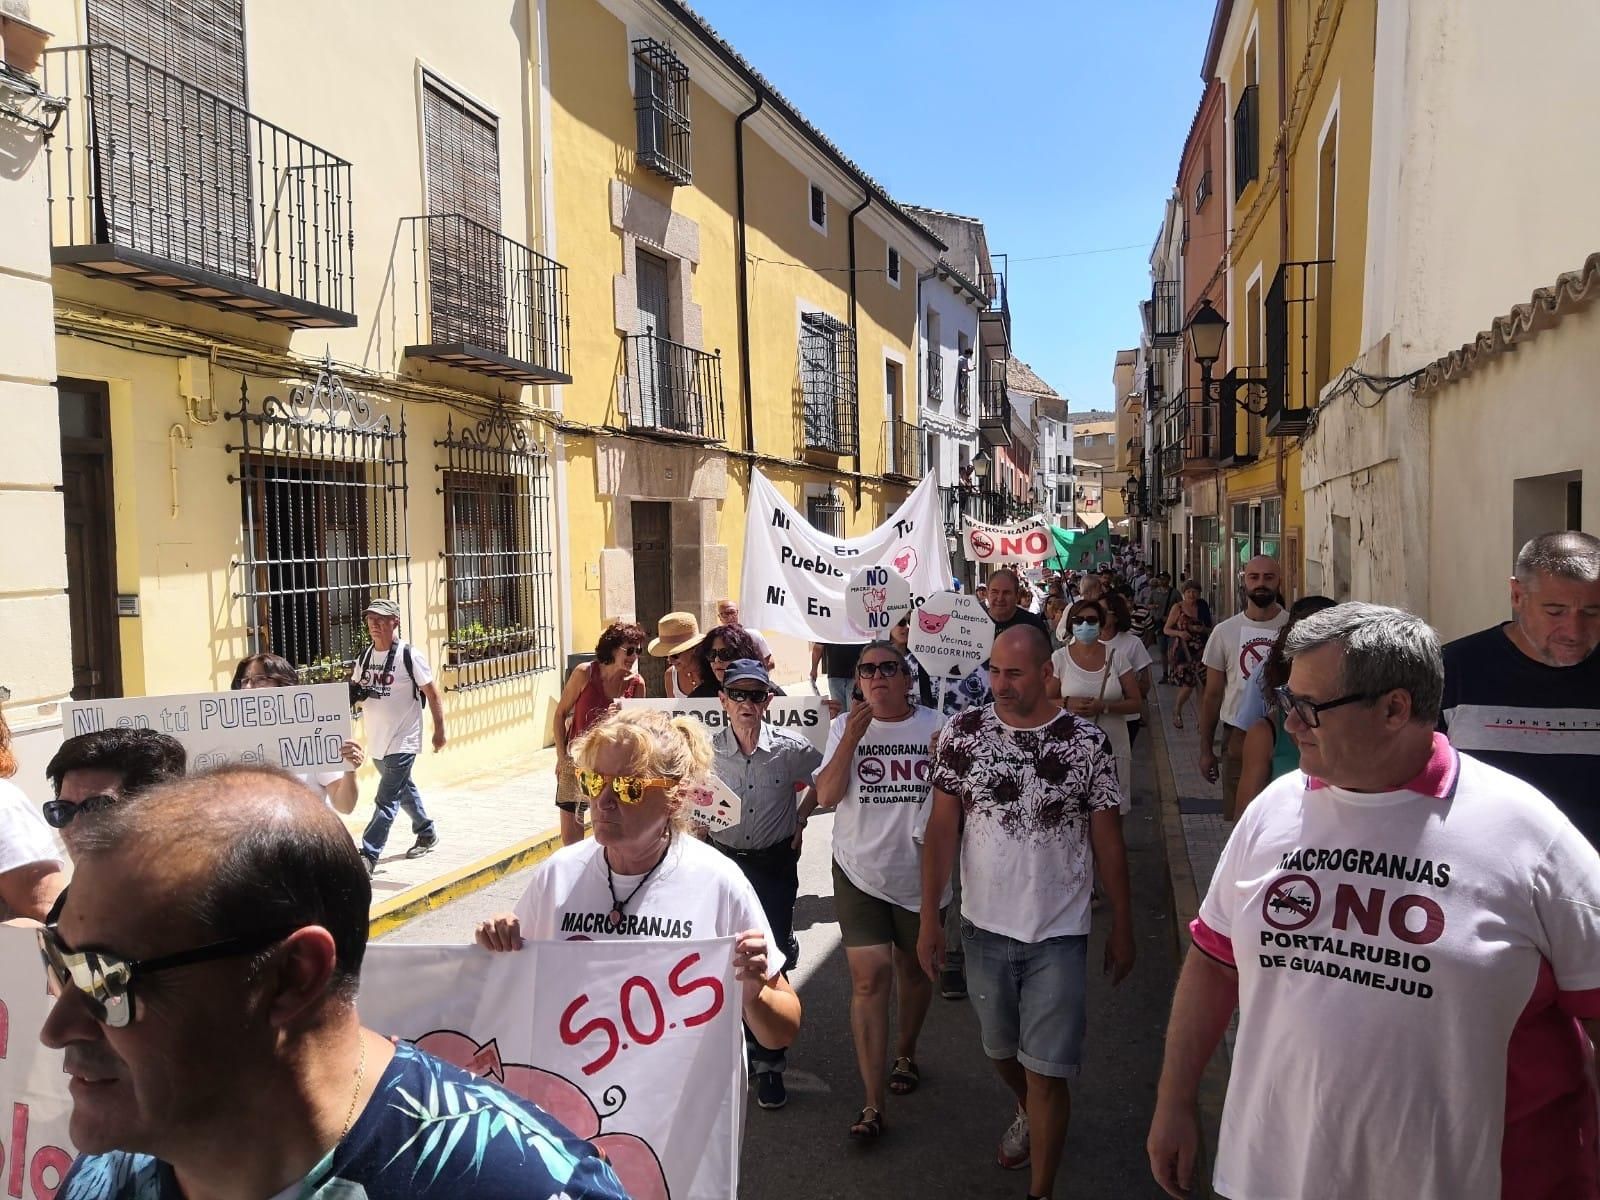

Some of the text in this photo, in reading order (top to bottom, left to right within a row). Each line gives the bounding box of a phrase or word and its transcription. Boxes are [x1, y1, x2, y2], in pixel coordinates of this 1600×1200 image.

[772, 508, 913, 556] Ni En Tu
[1000, 532, 1048, 556] NO
[866, 569, 888, 586] NO
[766, 585, 786, 606] Ni
[807, 597, 831, 618] En
[955, 598, 971, 607] NO
[868, 611, 890, 628] NO
[951, 610, 988, 624] Queremos
[940, 634, 973, 647] Vecinos
[960, 626, 971, 635] De
[937, 648, 981, 660] GORRINOS
[73, 706, 104, 736] NI
[115, 711, 150, 729] en
[160, 705, 189, 733] tú
[279, 727, 344, 767] MÍO
[858, 744, 929, 756] MACROGRANJA
[891, 760, 930, 781] NO
[860, 785, 931, 793] PORTALRUBIO
[1276, 848, 1451, 888] MACROGRANJAS
[1332, 884, 1445, 944] NO
[561, 912, 692, 939] MACROGRANJAS
[1260, 931, 1431, 973] PORTALRUBIO
[1259, 954, 1433, 999] DE GUADAMEJUD
